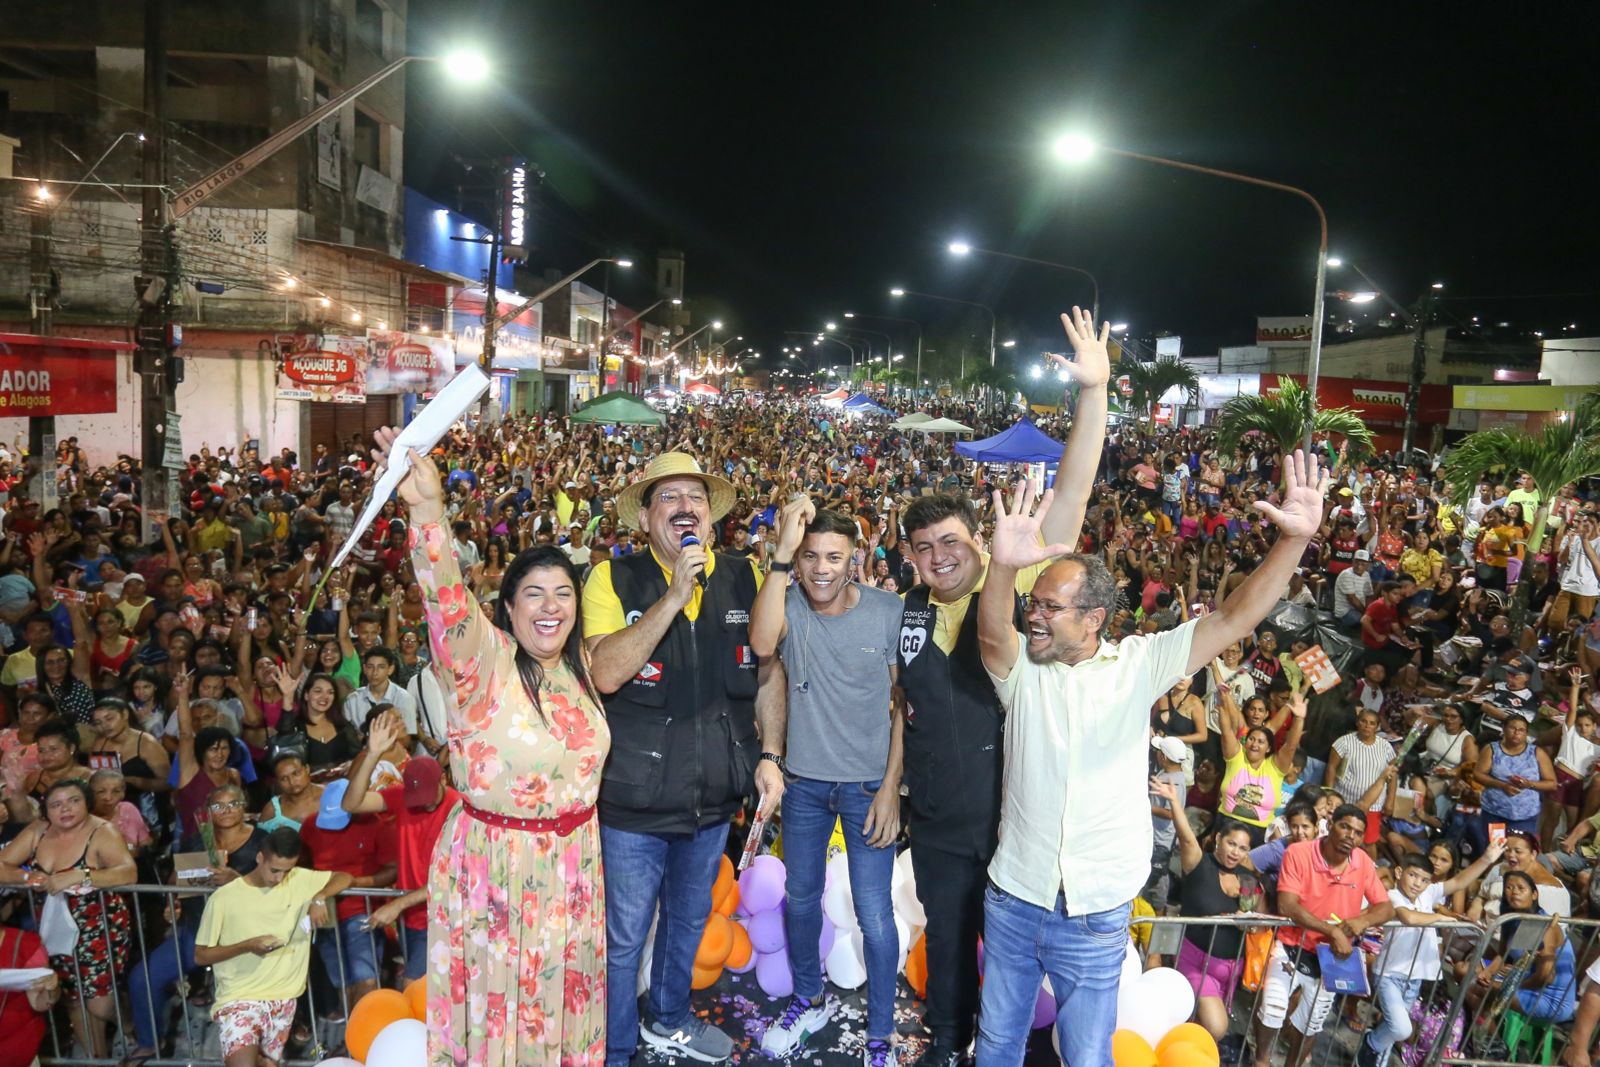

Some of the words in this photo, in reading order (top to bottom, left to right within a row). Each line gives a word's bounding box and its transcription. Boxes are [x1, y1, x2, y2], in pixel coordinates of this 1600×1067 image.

[183, 189, 204, 206] RIO
[207, 162, 244, 190] LARGO
[293, 358, 334, 373] AÇOUGUE
[335, 359, 347, 373] JG
[395, 351, 427, 369] AÇOUGUE
[9, 393, 52, 409] Alagoas
[904, 610, 931, 619] CORAÇÃO
[904, 618, 926, 626] GRANDE
[902, 635, 920, 653] CG
